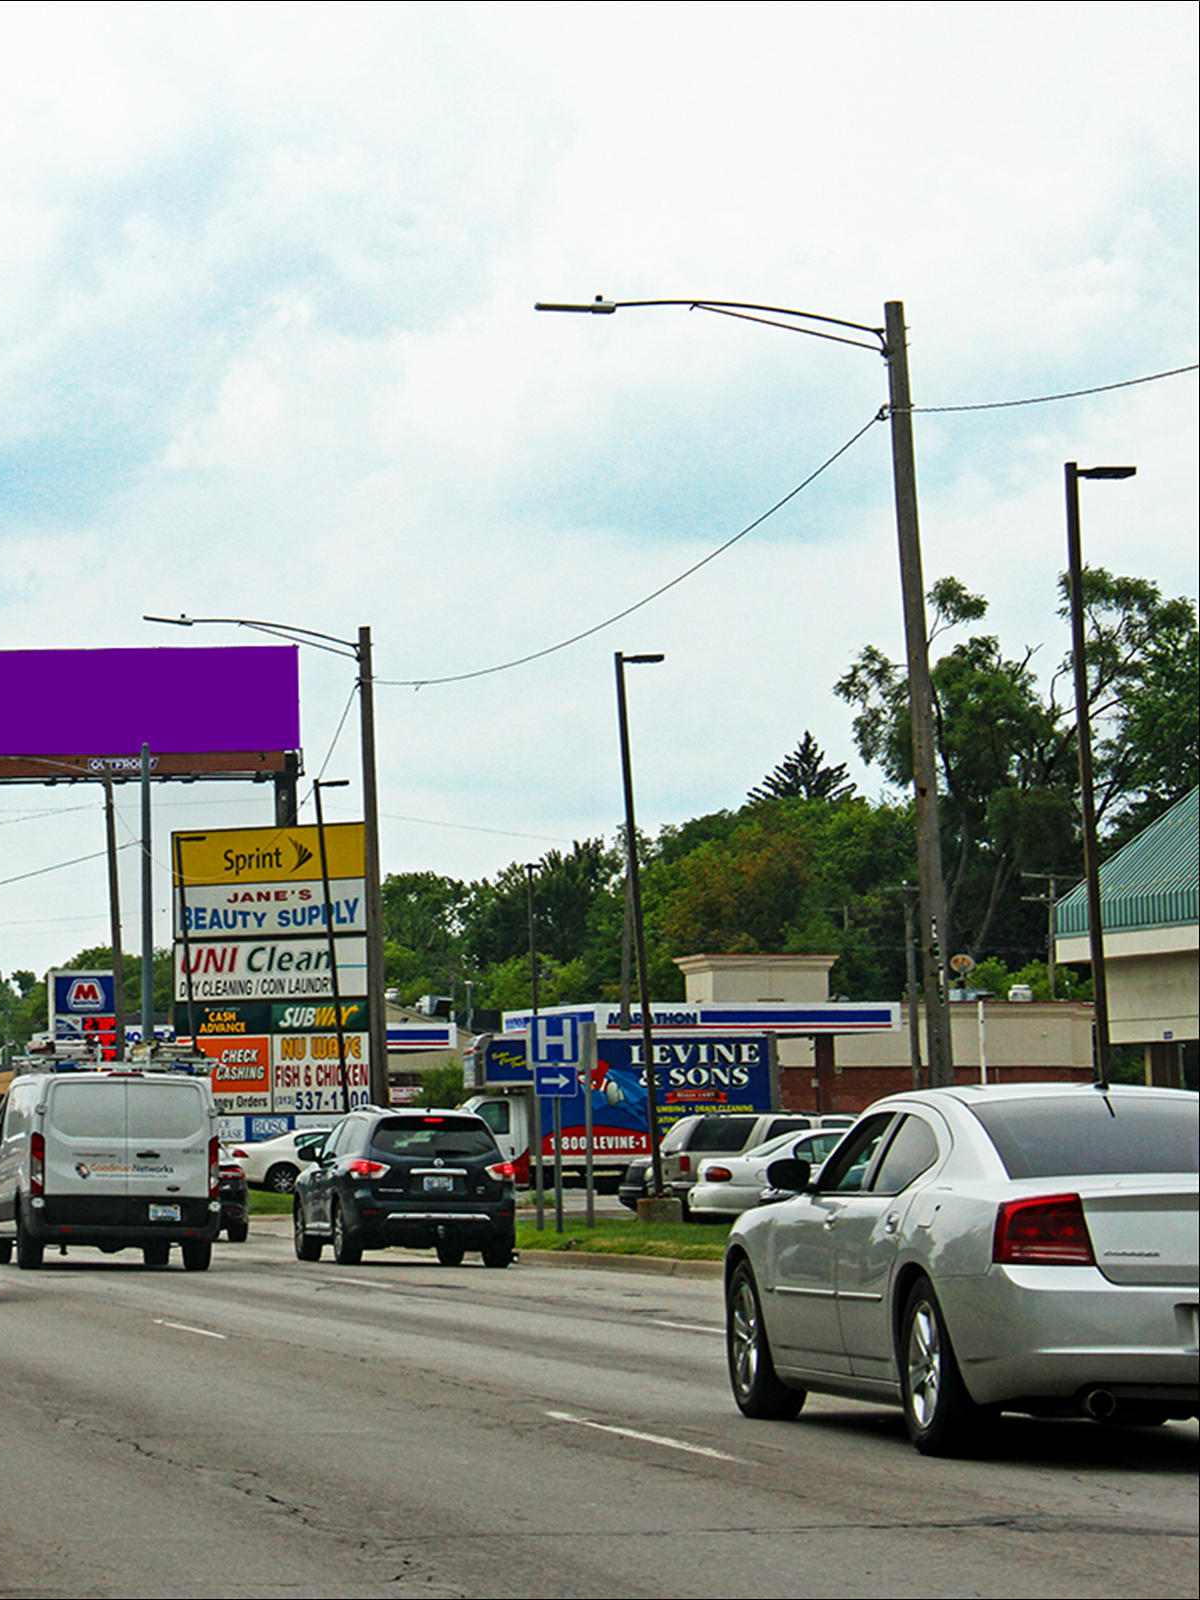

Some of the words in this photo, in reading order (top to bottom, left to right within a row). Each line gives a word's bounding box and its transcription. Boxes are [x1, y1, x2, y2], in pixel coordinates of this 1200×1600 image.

[90, 758, 153, 770] OUTFRO
[224, 848, 282, 875] Sprint
[227, 889, 313, 903] JANE'S
[179, 906, 267, 931] BEAUTY
[278, 898, 360, 927] SUPPLY
[180, 947, 239, 974] UNI
[247, 946, 332, 973] Clean
[179, 981, 200, 997] DY
[202, 979, 253, 997] CLEANING
[261, 978, 286, 995] COIN
[208, 1011, 237, 1022] CASH
[278, 1005, 359, 1028] SUBWAY
[608, 1012, 698, 1025] MRTHON
[199, 1022, 246, 1034] ADVANCE
[537, 1018, 573, 1061] H
[221, 1049, 260, 1064] CHECK
[281, 1037, 307, 1060] NU
[630, 1043, 760, 1066] LEVINE
[216, 1066, 266, 1082] CASHING
[274, 1064, 301, 1088] FISH
[304, 1064, 313, 1088] &
[316, 1063, 370, 1087] CHICKEN
[638, 1067, 663, 1087] &
[669, 1067, 749, 1087] SONS
[236, 1095, 268, 1108] Orders
[656, 1105, 687, 1113] UMBING
[90, 1163, 174, 1174] GoodmanNetworks
